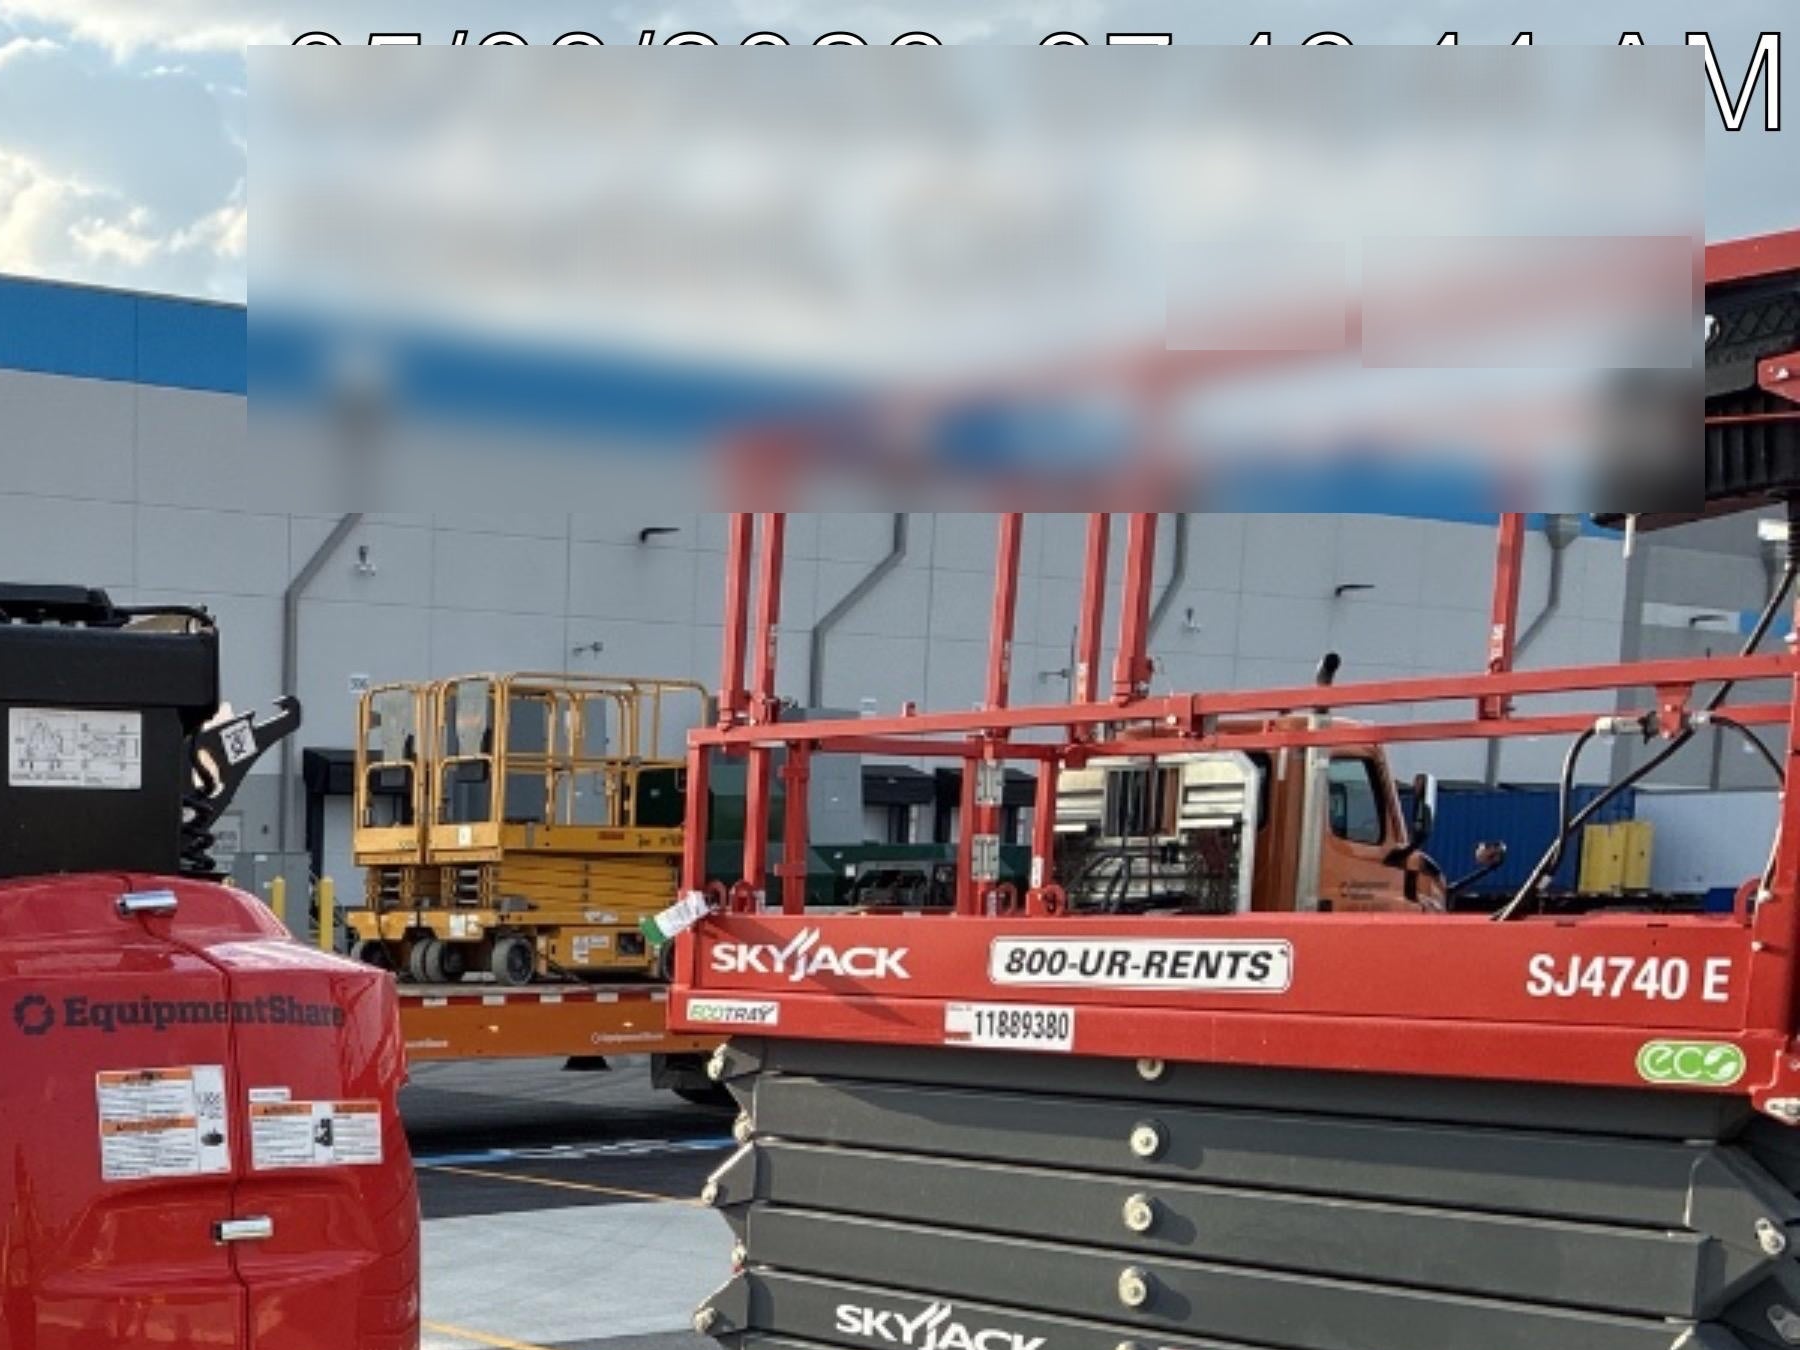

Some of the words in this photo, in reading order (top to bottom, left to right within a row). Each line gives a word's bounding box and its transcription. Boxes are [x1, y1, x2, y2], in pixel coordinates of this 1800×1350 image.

[710, 927, 911, 982] SKYJACK
[1004, 947, 1275, 982] 800-UR-RENTS
[1526, 953, 1689, 1000] SJ4740
[1702, 957, 1732, 1001] E
[63, 993, 346, 1032] EquipmentShare
[975, 1010, 1070, 1040] 11889380
